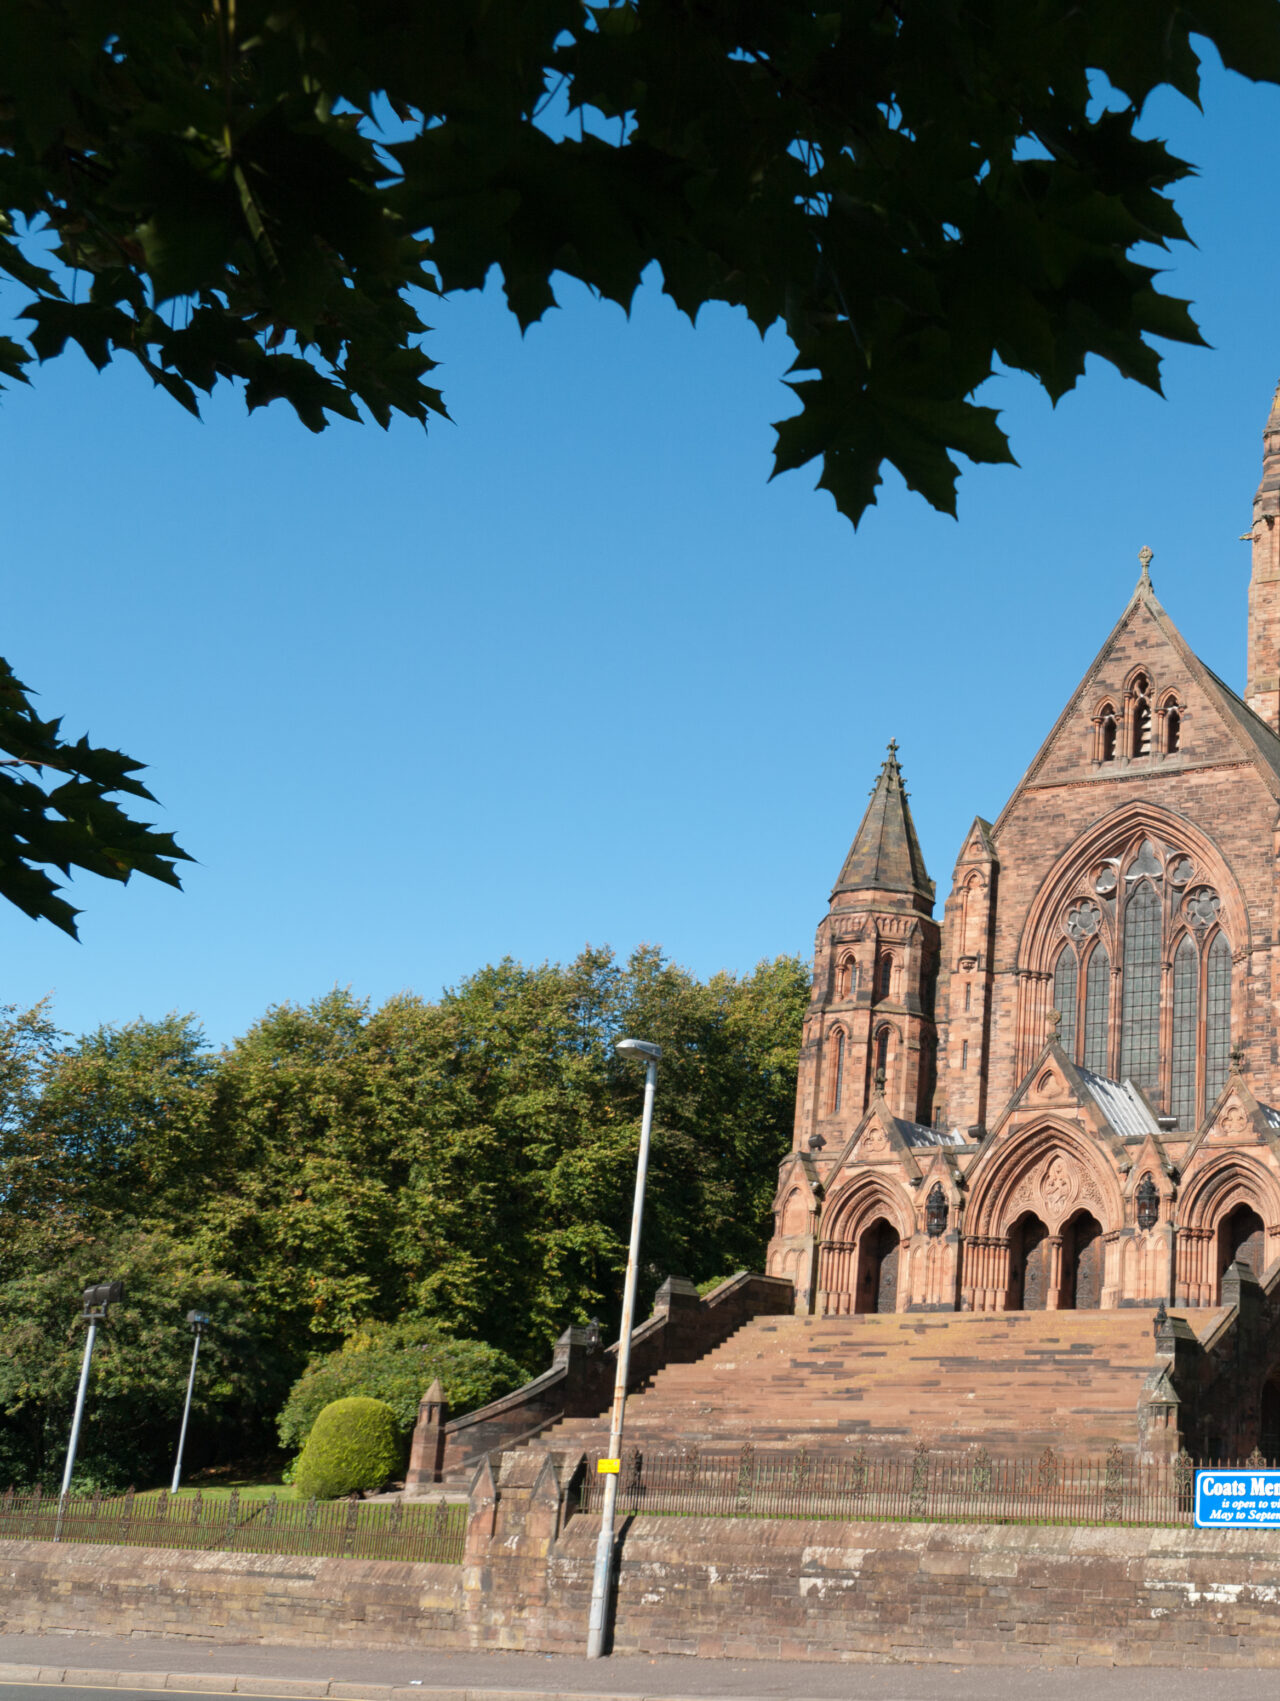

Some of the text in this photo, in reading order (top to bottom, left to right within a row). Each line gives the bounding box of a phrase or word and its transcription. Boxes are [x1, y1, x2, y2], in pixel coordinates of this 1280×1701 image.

[1203, 1478, 1246, 1496] Coats
[1222, 1499, 1229, 1508] is
[1231, 1501, 1255, 1510] open
[1258, 1499, 1268, 1508] to
[1209, 1510, 1234, 1521] May
[1235, 1511, 1246, 1519] to
